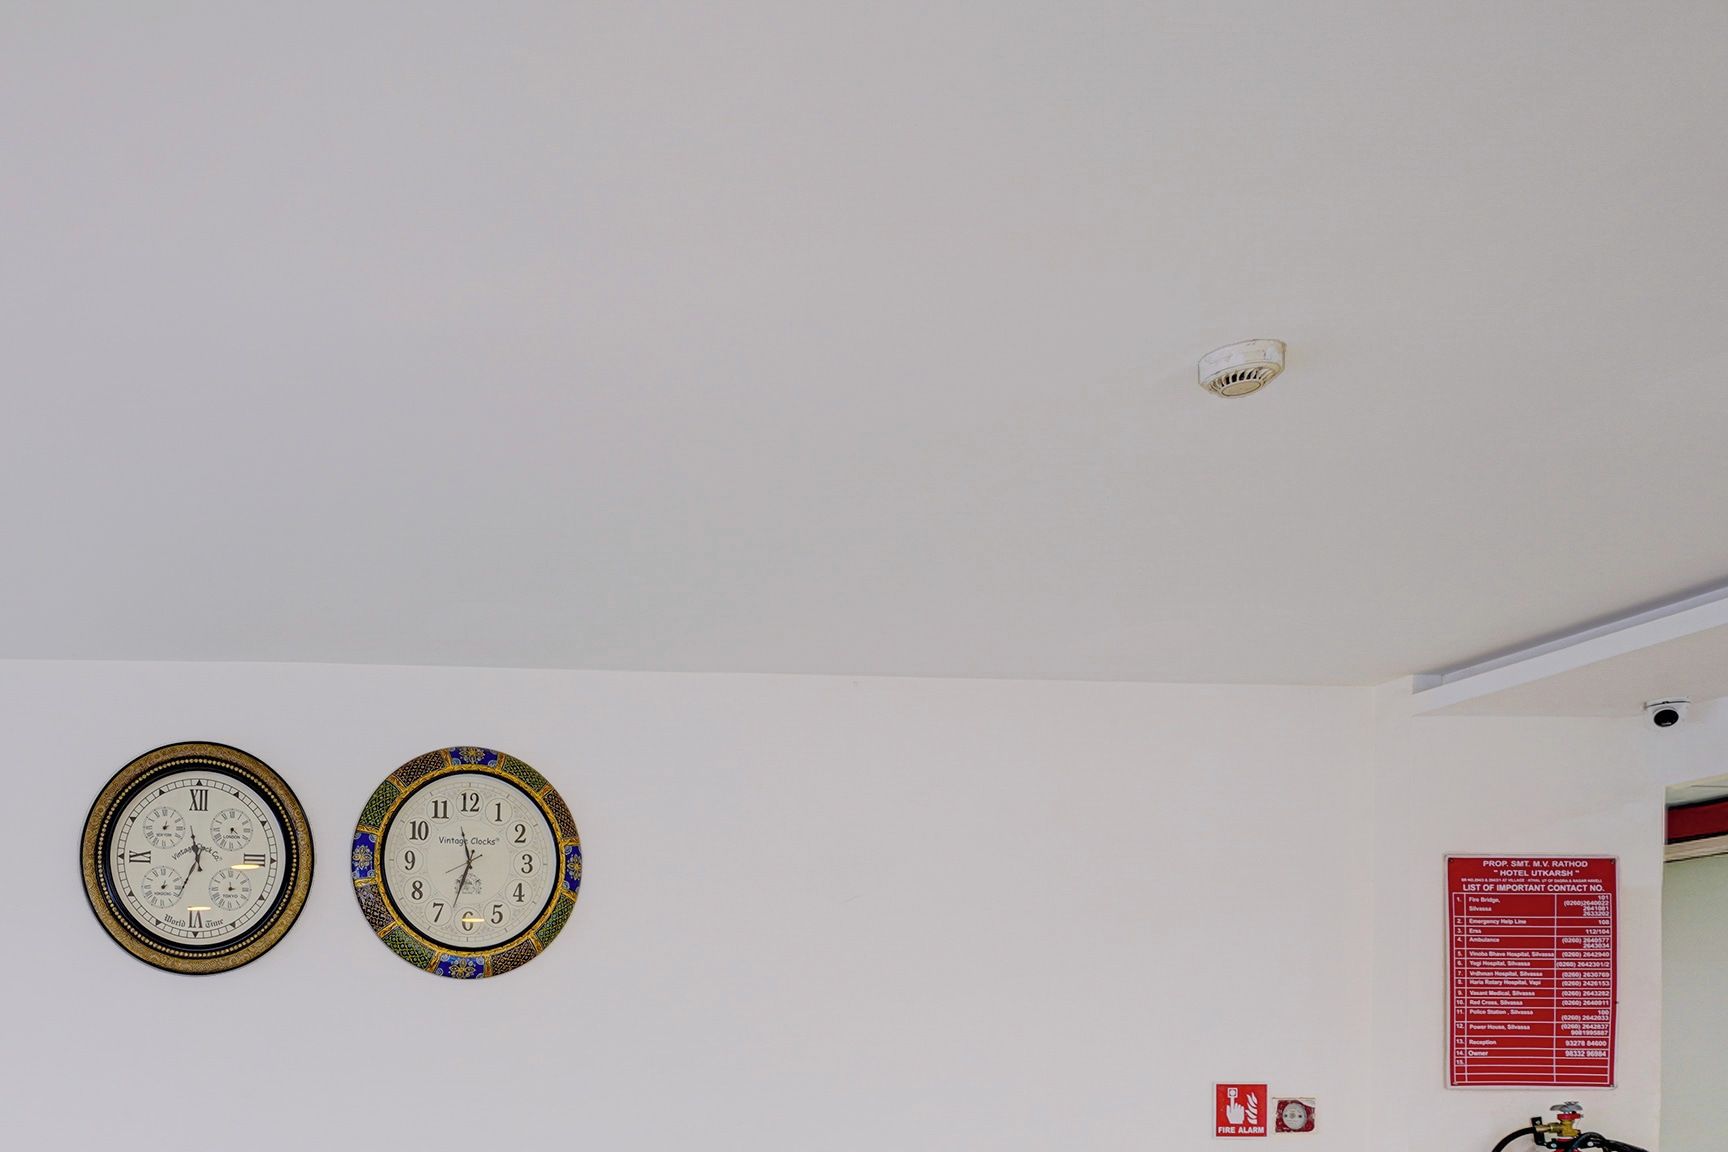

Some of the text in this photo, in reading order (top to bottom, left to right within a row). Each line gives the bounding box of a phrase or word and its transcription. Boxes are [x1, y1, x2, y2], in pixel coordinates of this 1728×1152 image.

[189, 789, 208, 811] XII
[432, 800, 449, 819] 11
[460, 792, 480, 812] 12
[495, 803, 502, 822] 1
[410, 820, 429, 840] 10
[514, 824, 526, 843] 2
[471, 837, 496, 845] Clocks
[172, 846, 193, 860] Vintag
[404, 851, 415, 870] 9
[521, 854, 532, 874] 3
[1552, 860, 1588, 868] RATHOD
[411, 880, 423, 900] 8
[513, 883, 525, 902] 4
[1547, 884, 1588, 892] CONTACT
[1590, 884, 1605, 892] NO.
[433, 903, 444, 922] 7
[462, 912, 474, 931] 6
[491, 905, 503, 924] 5
